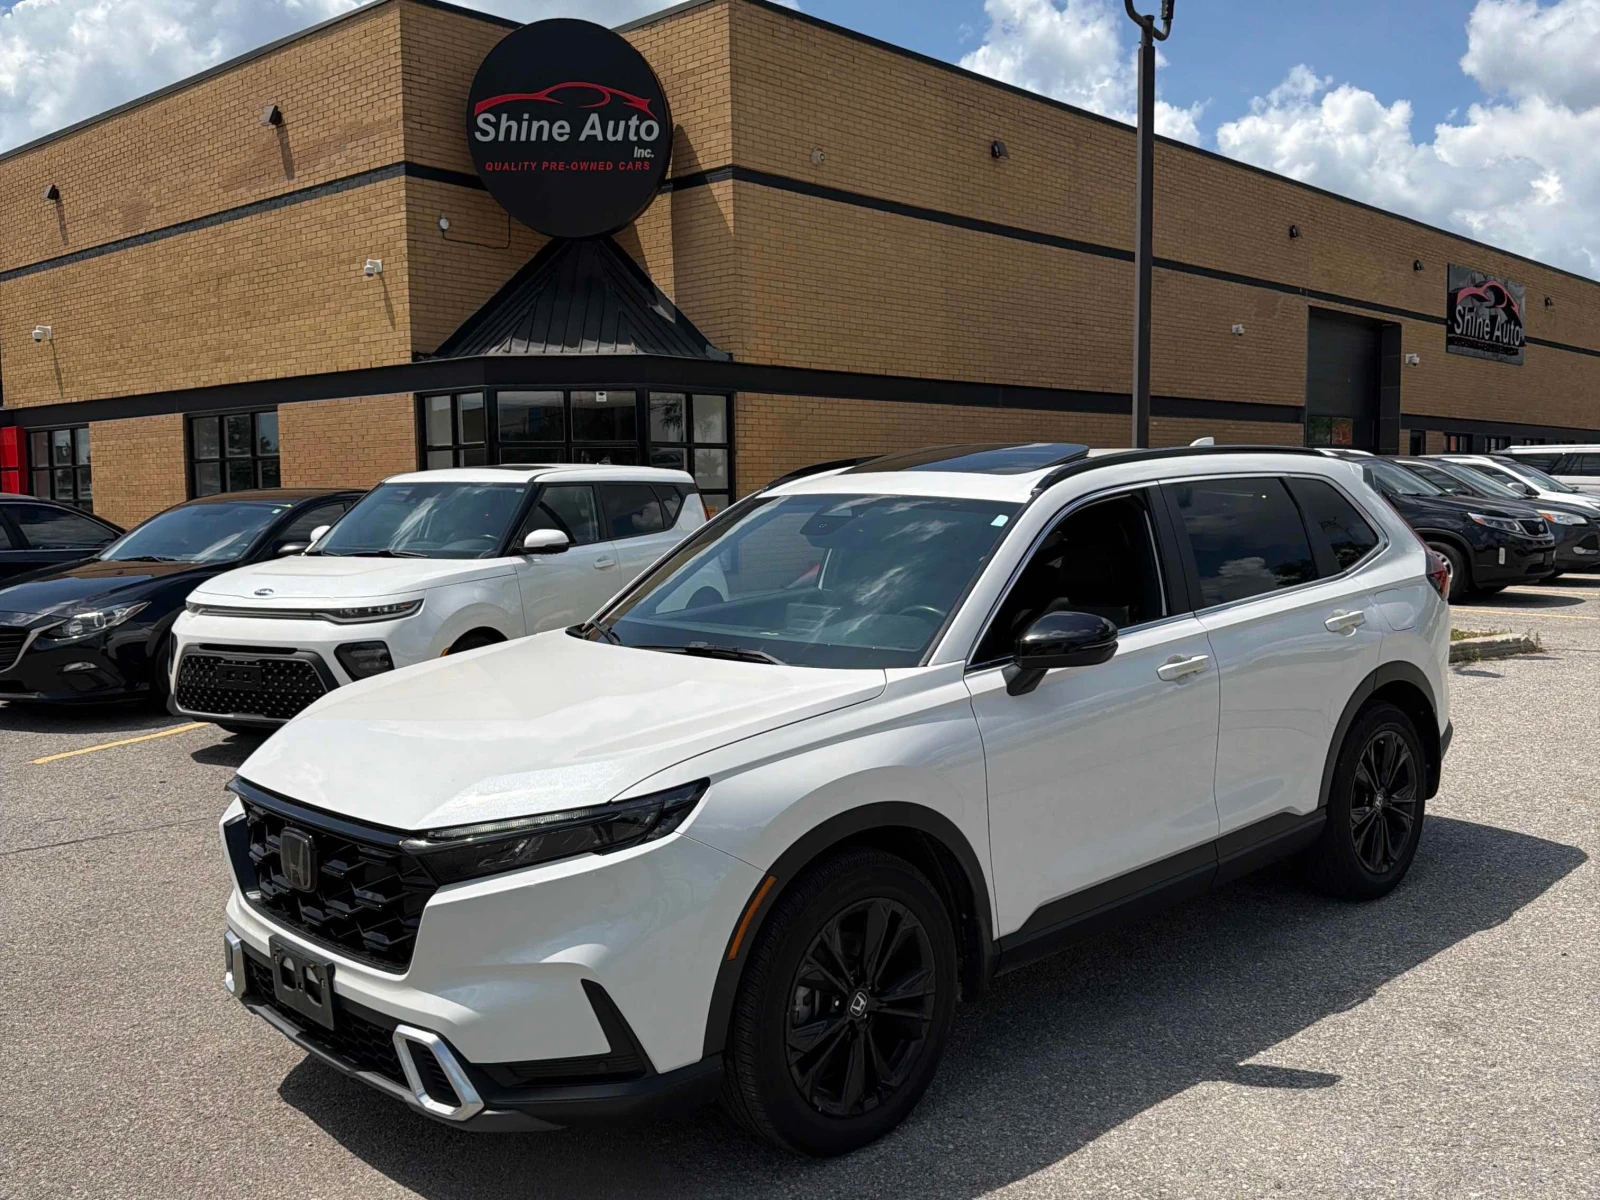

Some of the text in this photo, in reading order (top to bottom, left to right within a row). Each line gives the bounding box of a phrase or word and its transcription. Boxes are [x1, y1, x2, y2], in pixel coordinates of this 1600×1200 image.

[474, 113, 660, 142] Shine Auto
[633, 146, 655, 158] Inc.
[485, 161, 650, 171] QUALITY PRE-OWNED CARS
[1454, 305, 1521, 346] Shine Auto
